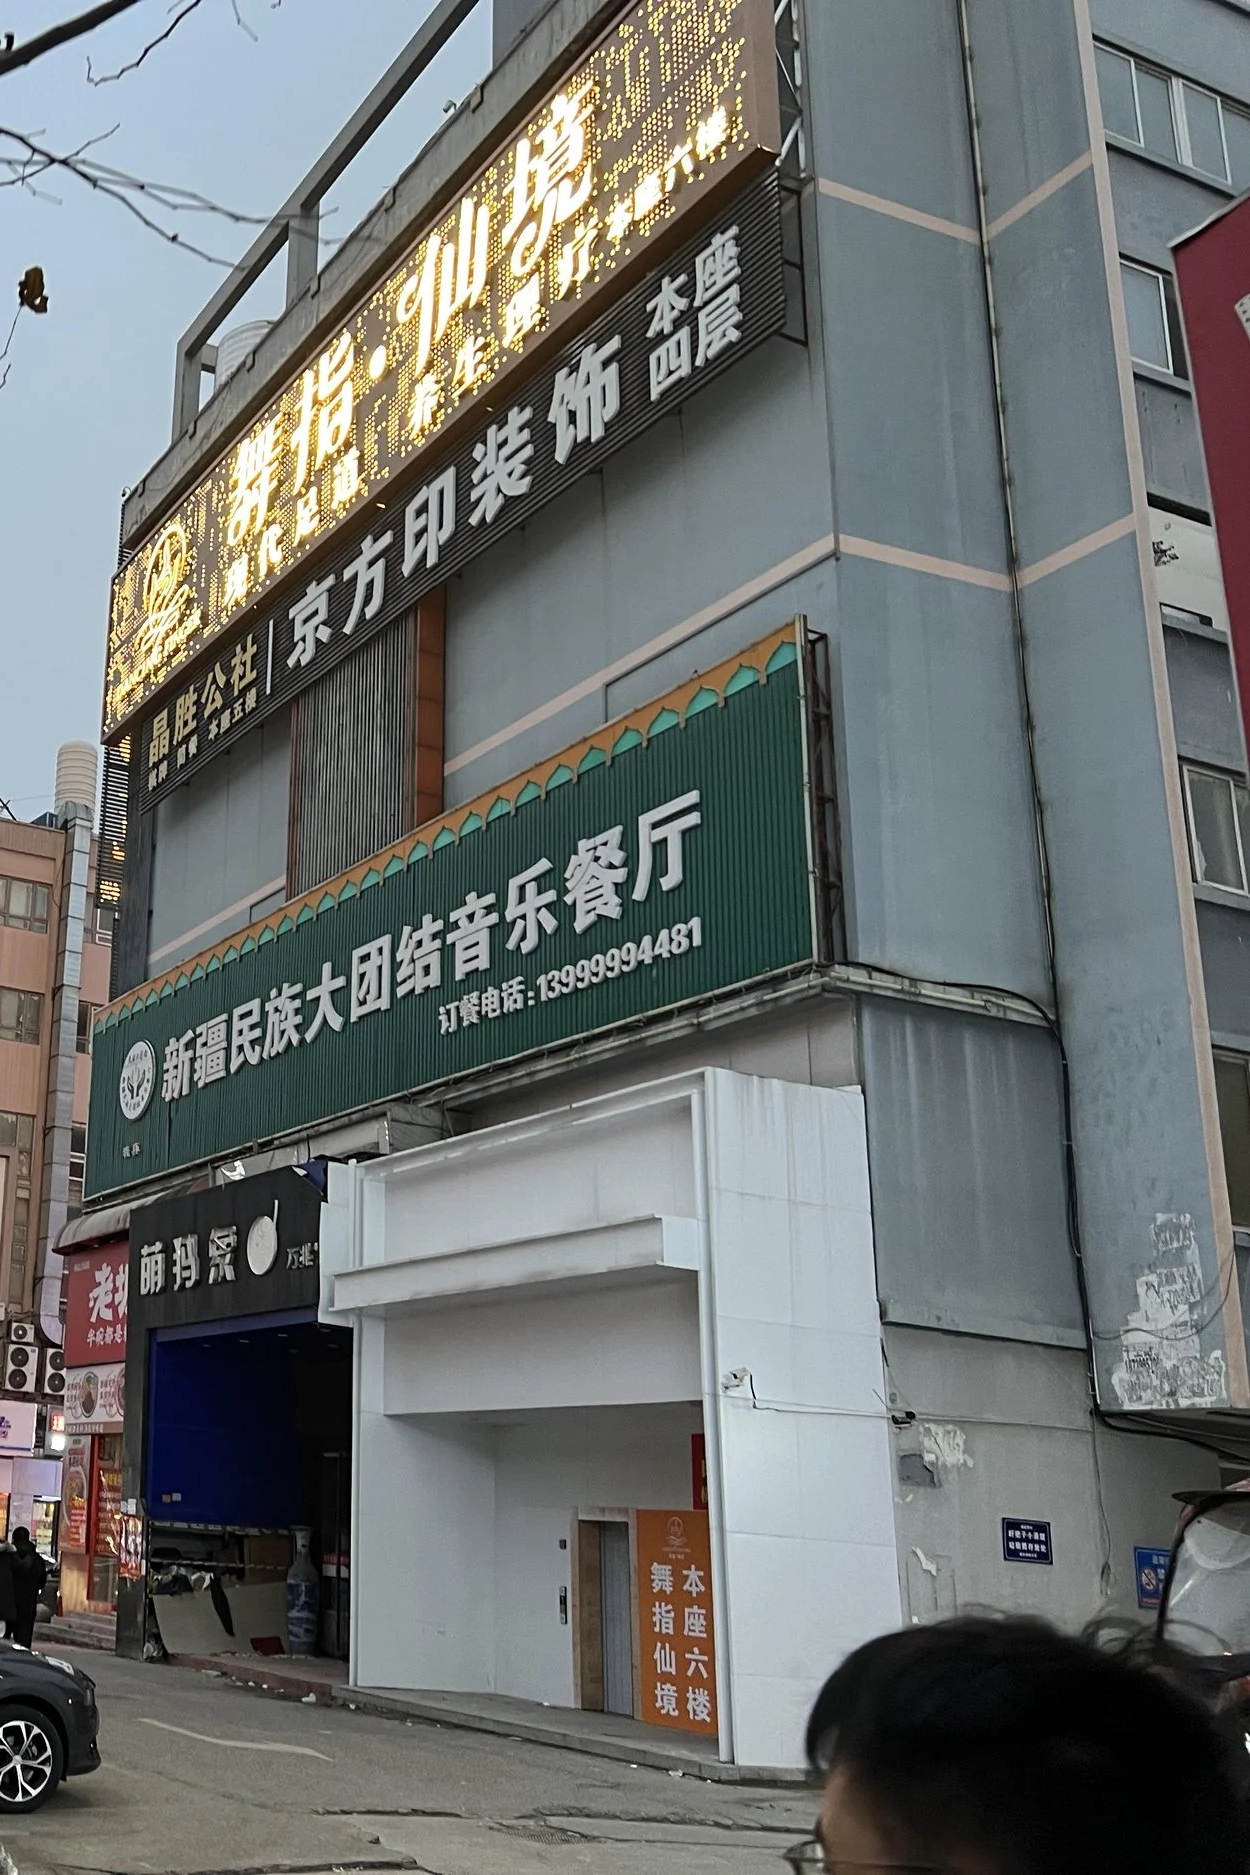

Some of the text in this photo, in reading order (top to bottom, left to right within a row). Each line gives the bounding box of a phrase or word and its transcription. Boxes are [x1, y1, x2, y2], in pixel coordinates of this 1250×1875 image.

[649, 284, 744, 402] 四层
[286, 333, 623, 670] 京方印装饰
[149, 634, 257, 768] 晶胜公社
[160, 790, 701, 1102] 新疆民族大团结音乐餐厅
[650, 1562, 711, 1723] 舞指仙境 本座六楼
